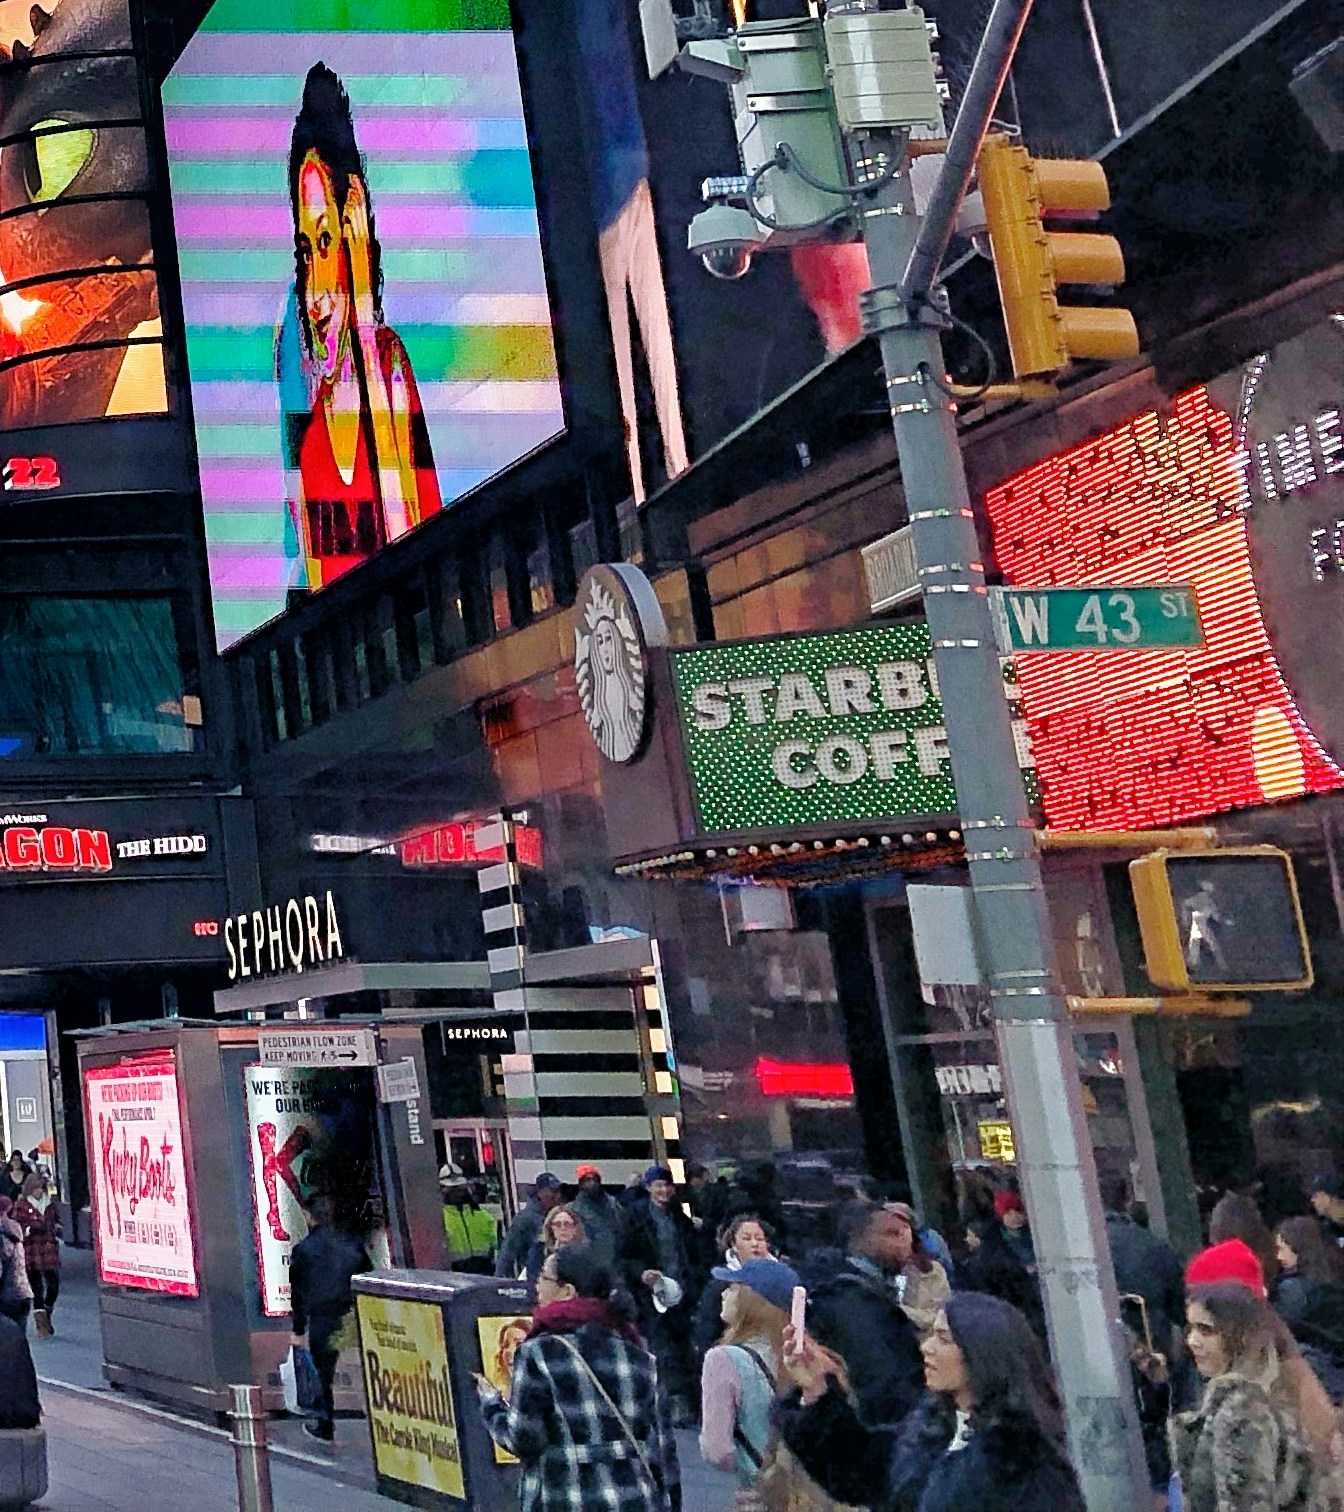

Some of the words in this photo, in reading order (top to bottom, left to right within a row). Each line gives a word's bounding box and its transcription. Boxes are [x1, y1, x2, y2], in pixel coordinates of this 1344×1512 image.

[2, 457, 61, 491] 22
[1010, 595, 1049, 645] W
[1075, 593, 1141, 644] 43
[1160, 592, 1189, 618] ST
[772, 726, 953, 791] COFF
[117, 839, 151, 859] THE
[154, 836, 206, 856] HIDD
[224, 890, 344, 980] SEPHORA
[262, 1037, 311, 1048] PEDESTRIAN
[313, 1036, 335, 1047] FLOW
[337, 1035, 357, 1046] ZONE
[447, 1028, 508, 1039] SEPHORA
[265, 1051, 284, 1062] KEEP
[286, 1050, 317, 1062] MOVING
[251, 1079, 291, 1096] WE'RE
[275, 1098, 301, 1113] OUR
[407, 1099, 424, 1144] stand
[140, 1136, 176, 1207] Boots
[367, 1350, 454, 1428] Beautiful
